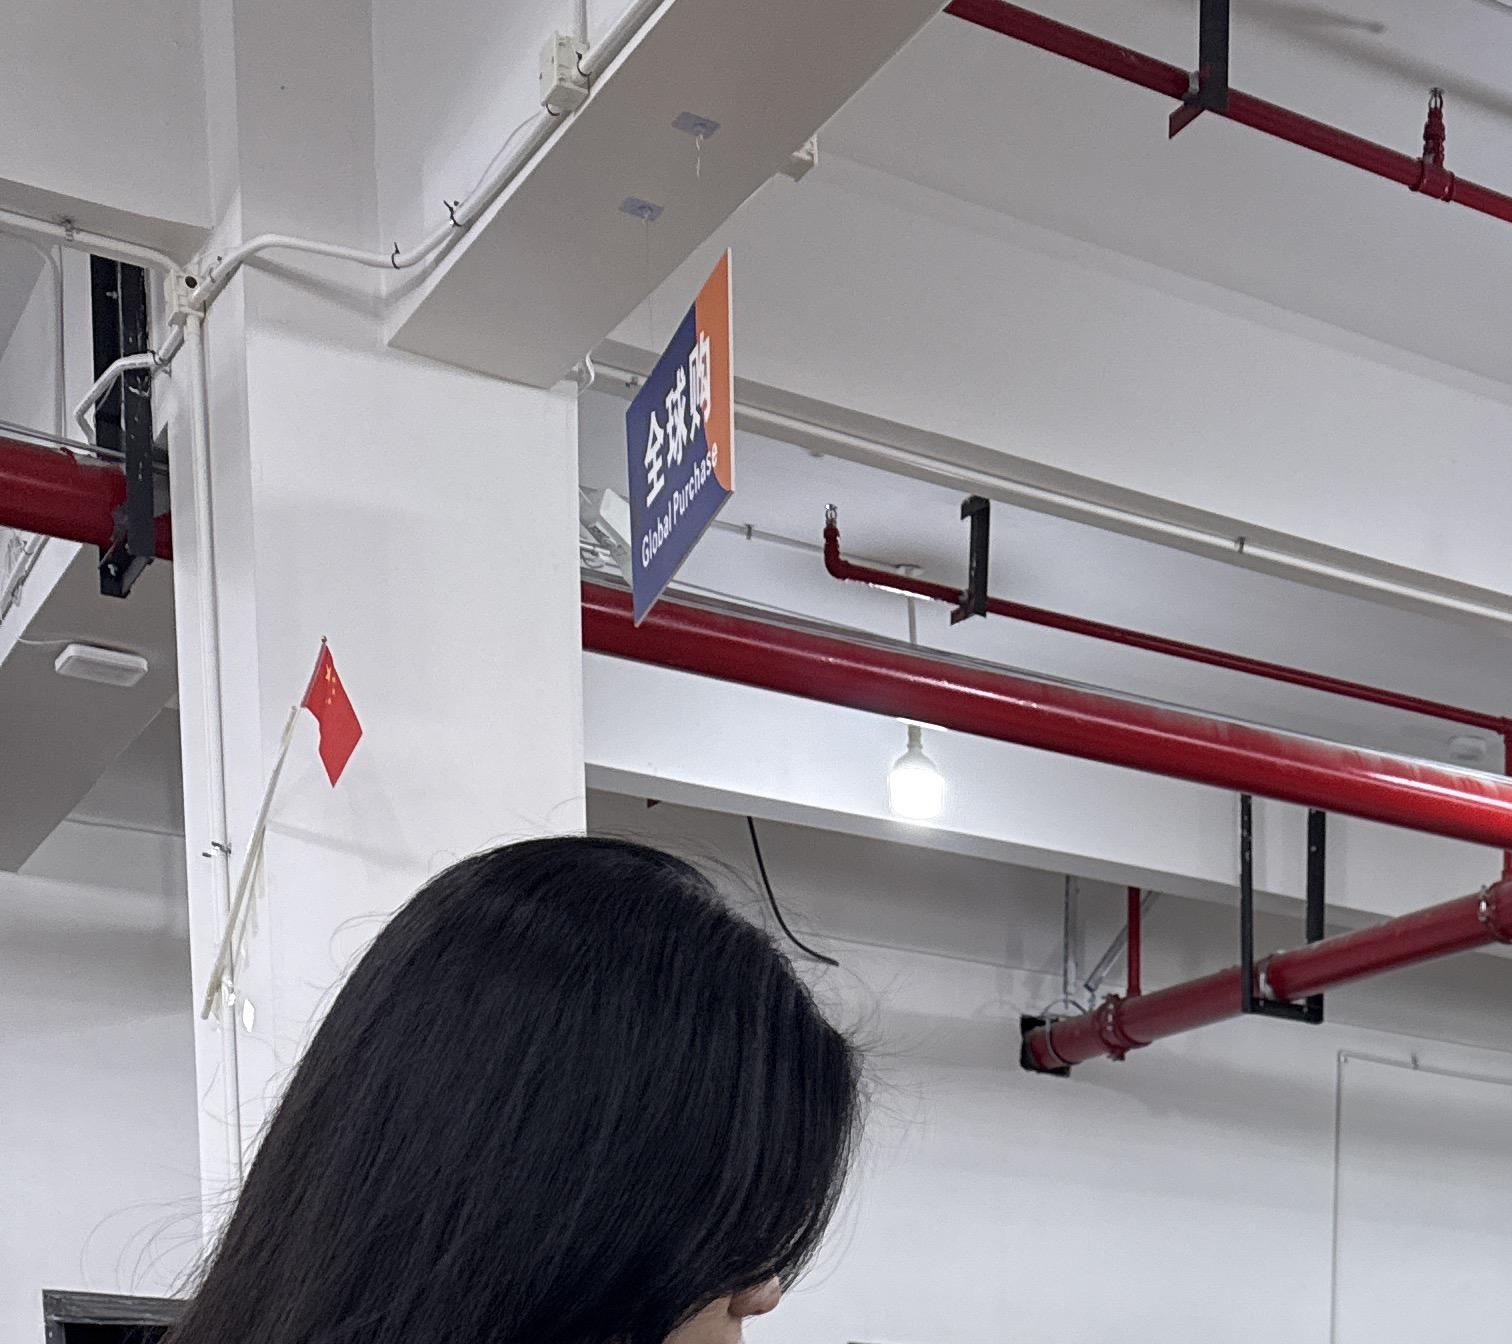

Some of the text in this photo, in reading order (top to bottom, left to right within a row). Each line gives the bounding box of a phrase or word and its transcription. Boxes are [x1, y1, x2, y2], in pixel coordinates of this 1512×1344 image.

[643, 331, 711, 508] 全球购
[641, 439, 718, 569] Global Purchase
